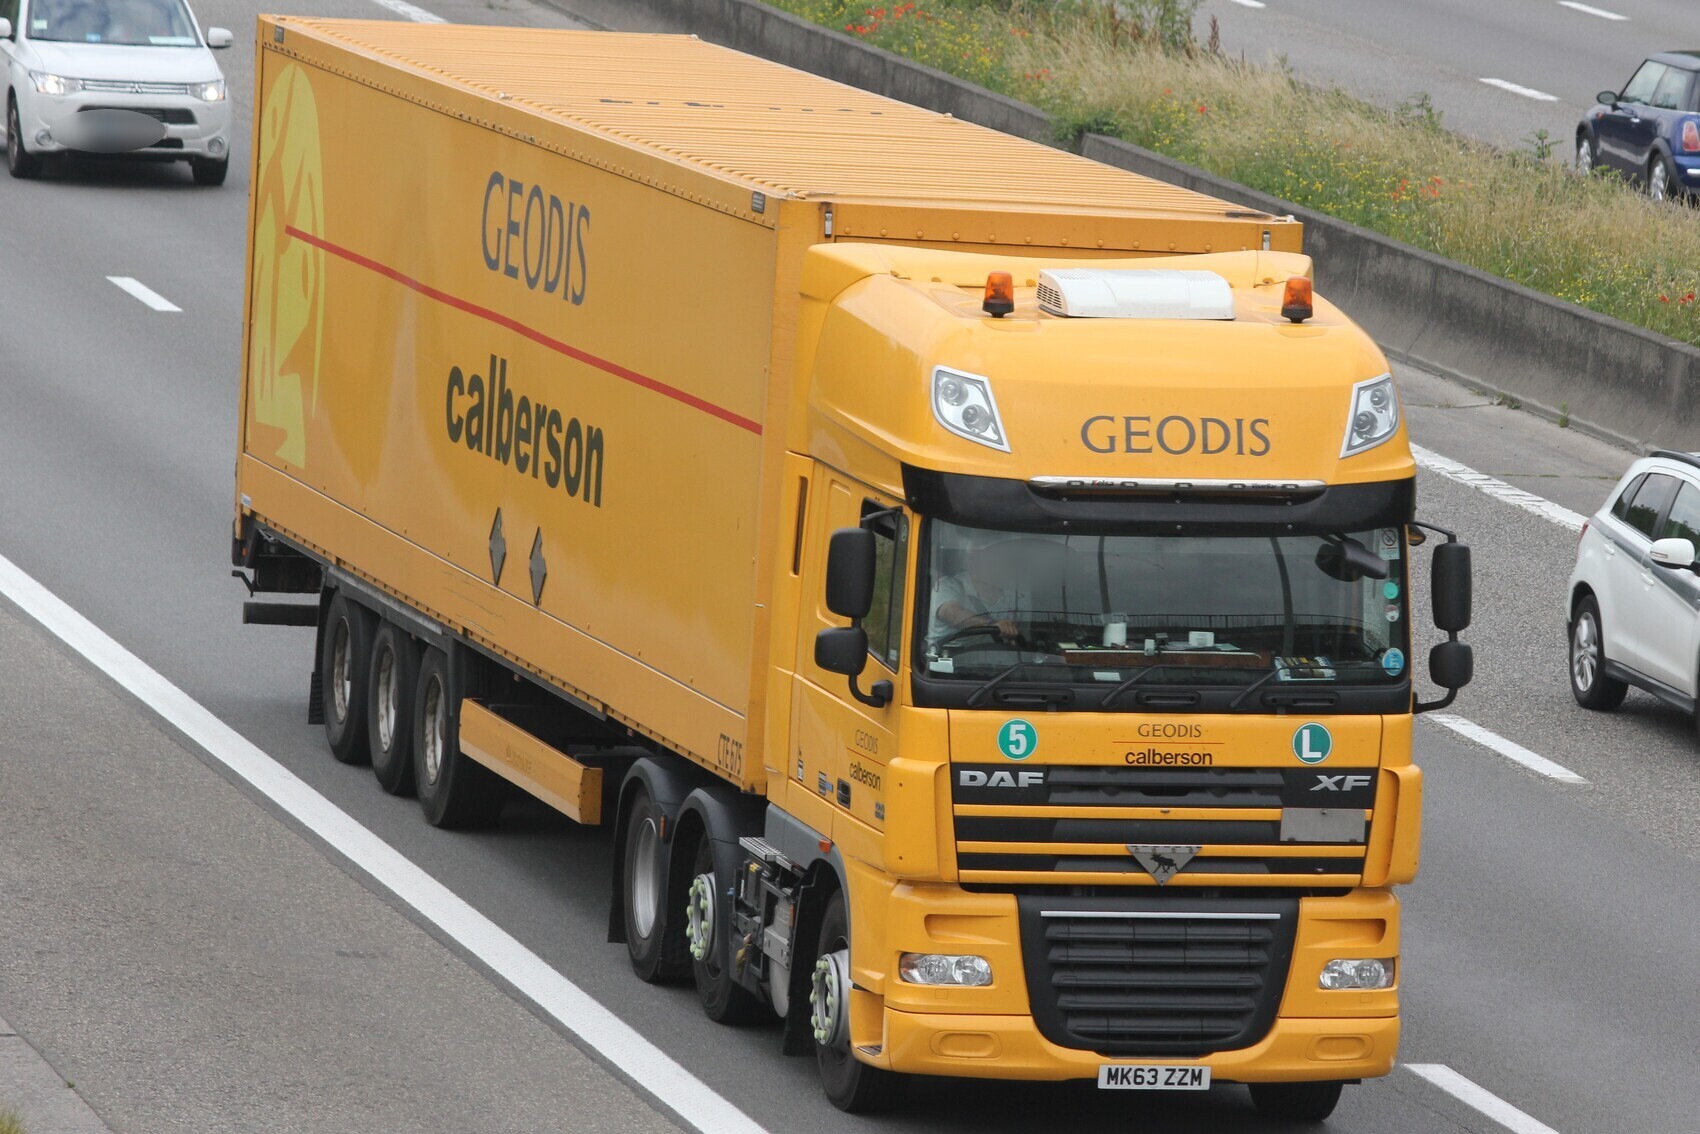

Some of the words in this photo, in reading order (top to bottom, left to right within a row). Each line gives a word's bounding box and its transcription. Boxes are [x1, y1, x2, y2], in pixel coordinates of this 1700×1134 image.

[481, 170, 591, 306] GEODIS
[446, 353, 605, 508] calberson
[1080, 414, 1271, 457] GEODIS
[855, 729, 878, 755] GEODIS
[1008, 723, 1028, 755] 5
[1137, 722, 1202, 739] GEODIS
[1300, 728, 1323, 759] L
[1124, 748, 1213, 766] calberson
[849, 761, 881, 791] calberson
[958, 770, 1044, 788] DAF
[1309, 774, 1372, 792] XF
[1106, 1067, 1159, 1086] MK63
[1163, 1068, 1203, 1086] ZZM
